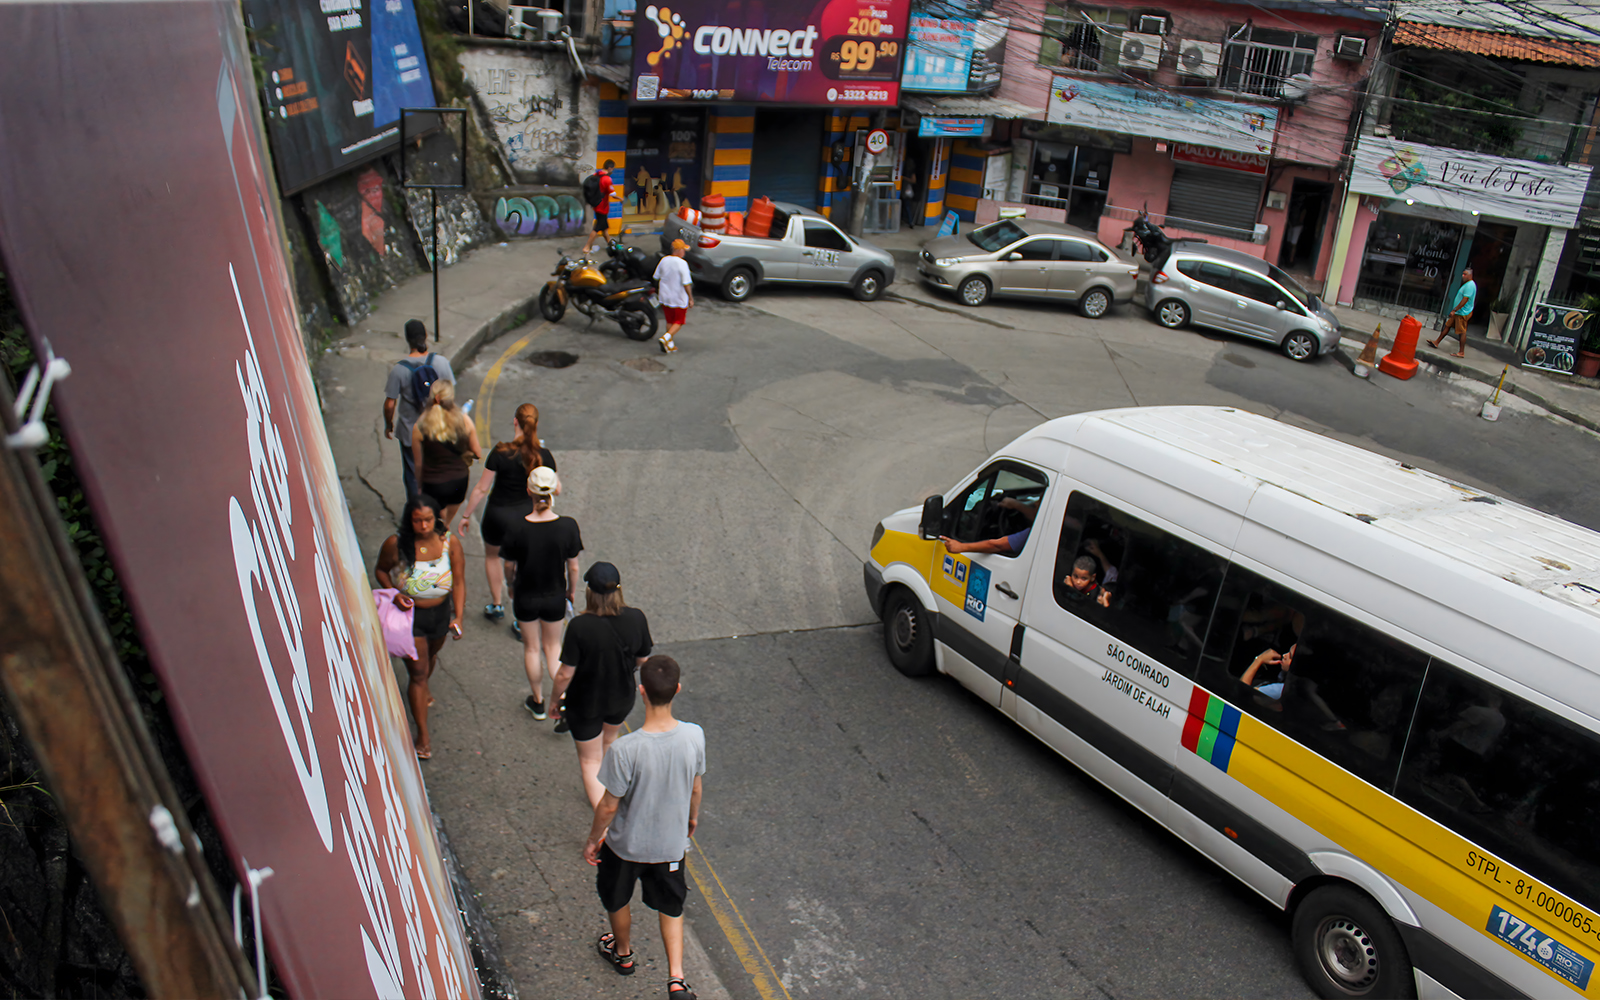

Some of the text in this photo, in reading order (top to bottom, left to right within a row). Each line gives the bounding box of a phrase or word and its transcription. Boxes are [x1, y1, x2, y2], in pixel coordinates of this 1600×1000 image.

[766, 56, 812, 71] Telecom
[843, 90, 889, 101] 3322-6213
[870, 134, 885, 146] 40
[1440, 160, 1557, 196] Vai de Festa
[1423, 265, 1439, 278] 10
[1106, 643, 1170, 690] SÃO CONRADO
[1101, 670, 1171, 720] JARDIM DE ALAH
[1466, 851, 1501, 884] STPL
[1498, 911, 1554, 960] 1746
[1555, 953, 1573, 968] RIO
